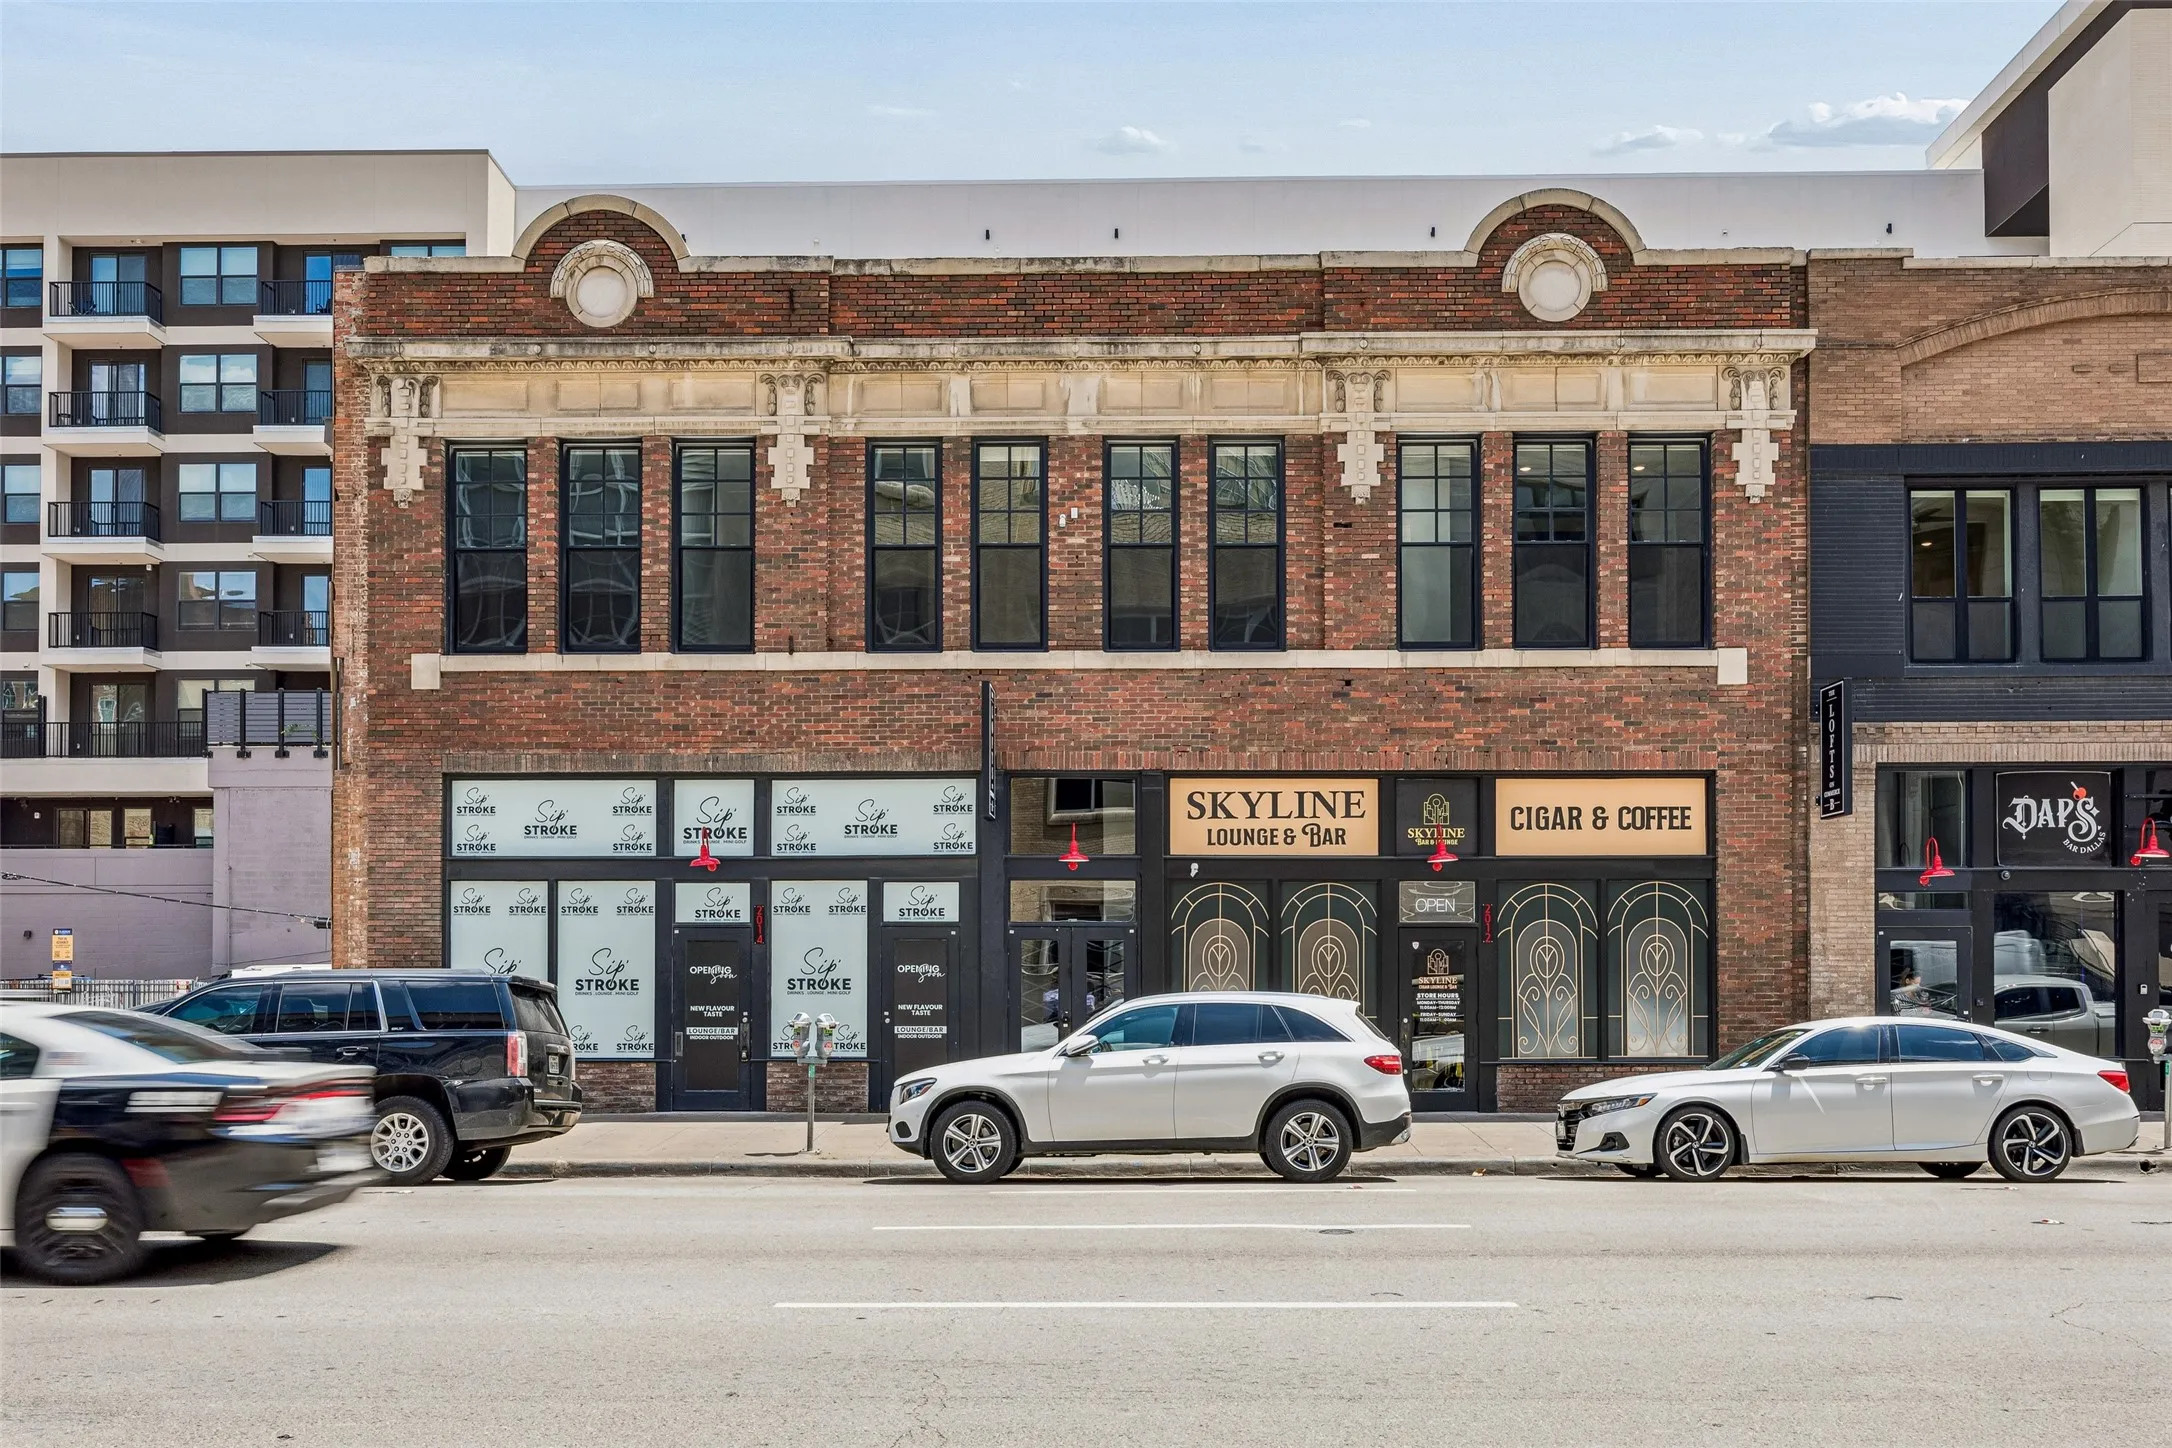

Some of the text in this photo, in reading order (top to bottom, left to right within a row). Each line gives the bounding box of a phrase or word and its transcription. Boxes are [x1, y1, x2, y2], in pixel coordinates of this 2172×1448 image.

[457, 806, 496, 814] STROKE
[1187, 790, 1366, 820] SKYLINE
[1511, 806, 1692, 830] CIGAR & COFFEE
[525, 826, 577, 835] STROKE
[684, 828, 747, 839] STROKE
[845, 825, 897, 834] STROKE
[1207, 823, 1346, 847] LOUNGE & BAR
[2063, 832, 2106, 853] BAR DALLAS
[1415, 899, 1455, 912] OPEN
[695, 910, 740, 918] STROKE
[899, 908, 944, 916] STROKE
[756, 906, 764, 944] 2014
[690, 966, 732, 974] OPENING
[575, 979, 639, 990] STROKE
[787, 978, 851, 990] STROKE
[1418, 976, 1458, 984] SKYLINE
